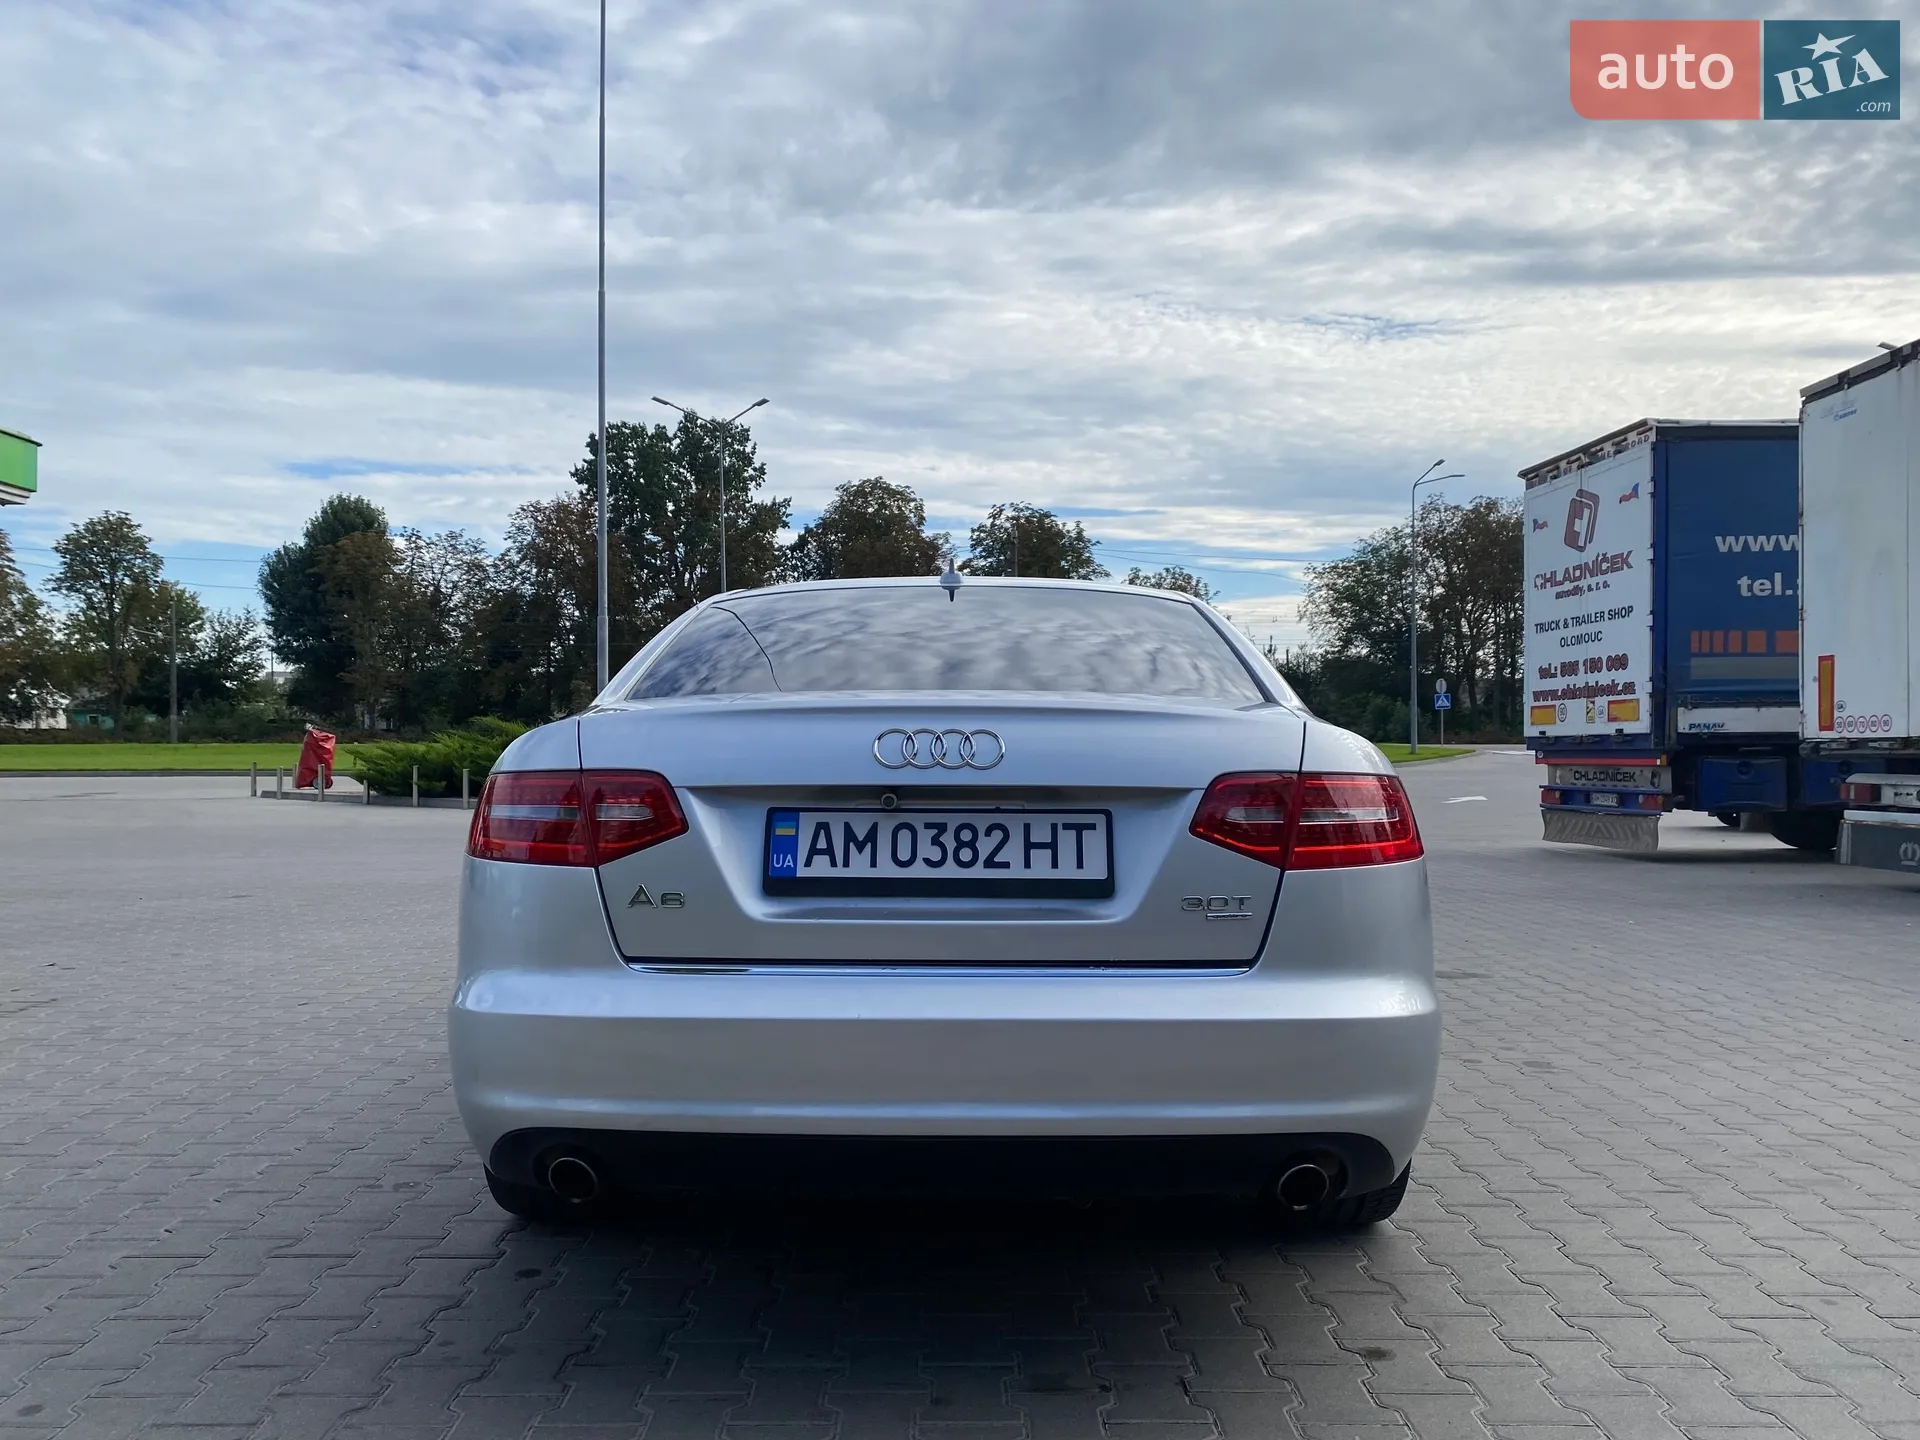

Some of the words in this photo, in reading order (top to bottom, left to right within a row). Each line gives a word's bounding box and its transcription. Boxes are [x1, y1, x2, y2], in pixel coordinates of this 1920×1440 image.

[1737, 572, 1799, 597] tel.
[1534, 619, 1561, 634] TRUCK
[1563, 617, 1570, 629] &
[1570, 611, 1606, 628] TRAILER
[1607, 605, 1634, 621] SHOP
[1560, 630, 1603, 648] OLOMOUC
[773, 853, 795, 868] UA
[803, 821, 878, 868] AM
[890, 821, 1011, 869] 0382
[1022, 822, 1098, 870] HT
[626, 883, 685, 909] A6
